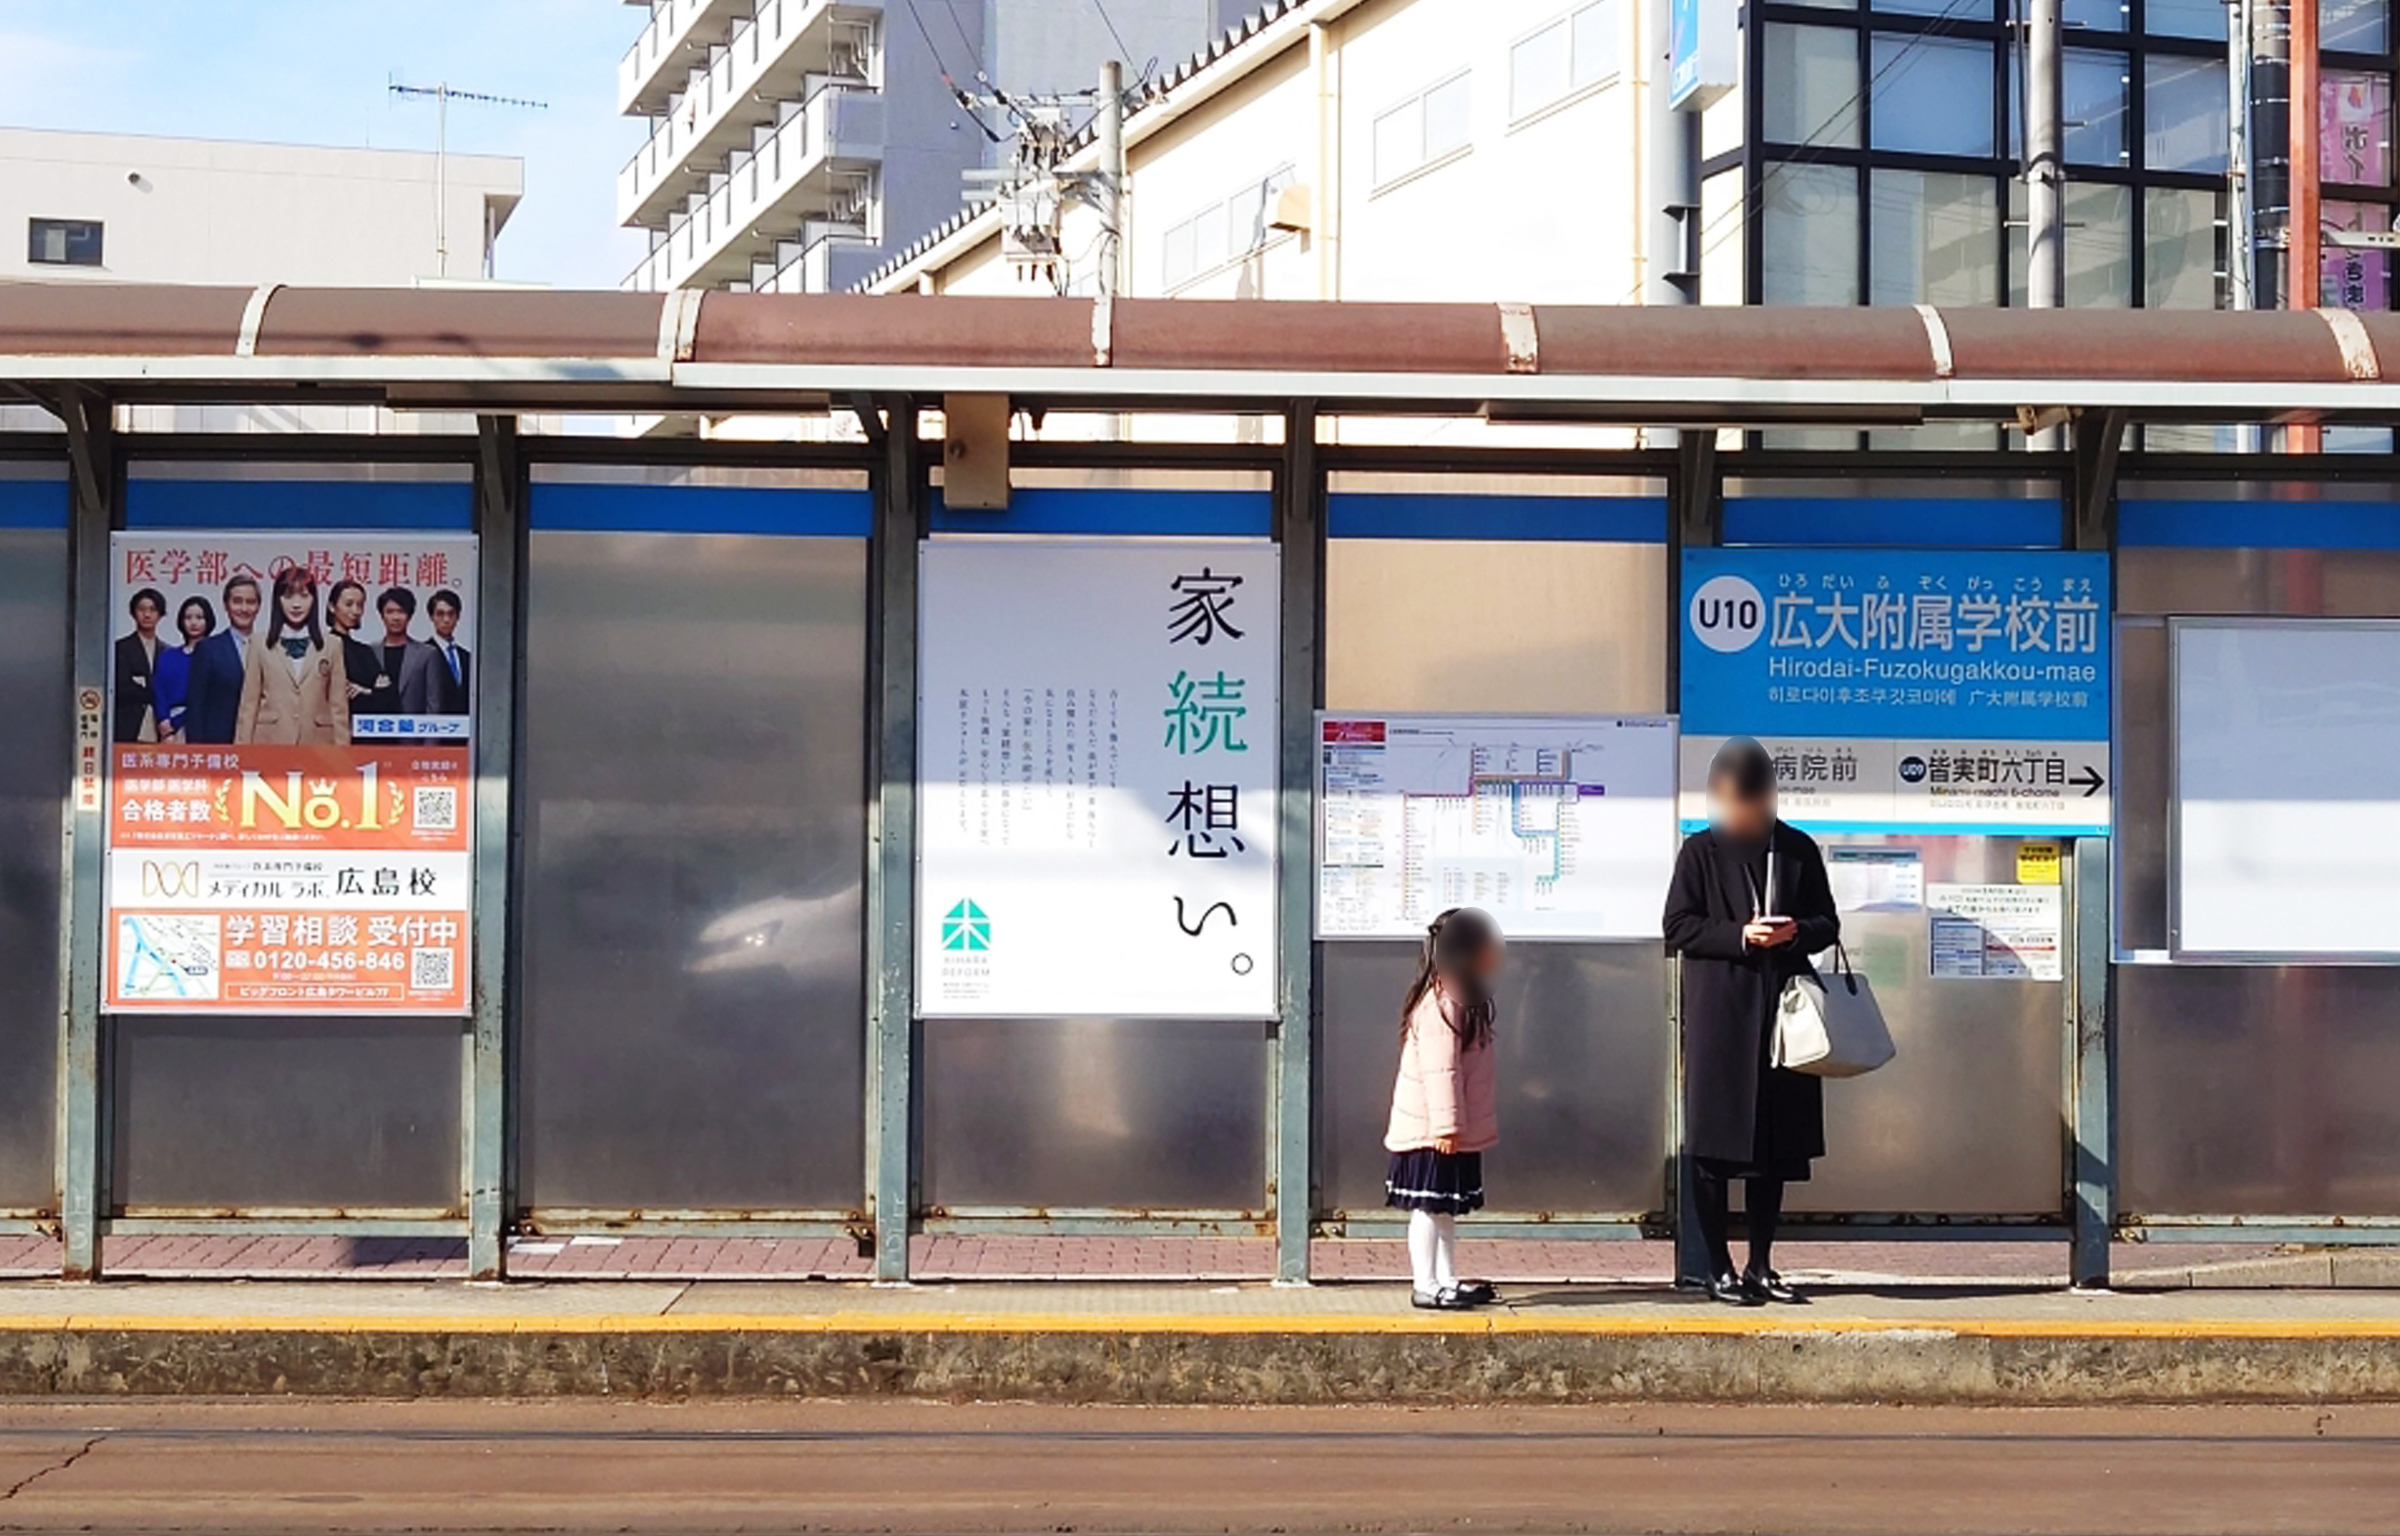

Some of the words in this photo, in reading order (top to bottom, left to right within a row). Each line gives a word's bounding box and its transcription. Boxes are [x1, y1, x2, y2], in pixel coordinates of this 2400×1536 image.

[126, 550, 462, 588] 医学部への最短距離。
[1779, 573, 1807, 588] ひろ
[1822, 574, 1854, 589] だい
[1877, 576, 1889, 588] ふ
[1919, 576, 1948, 590] ぞく
[1968, 577, 1993, 590] がっ
[2014, 578, 2043, 591] こう
[2063, 579, 2092, 592] まえ
[1699, 600, 1757, 629] U10
[1770, 591, 2099, 653] 広大附属学校前
[1770, 657, 2096, 684] Hirodai-Fuzokugakkou-mae
[357, 719, 460, 733] 河合塾グループ
[122, 753, 239, 769] 医系専門予備校
[1164, 567, 1253, 975] 家続想い。
[1774, 754, 1858, 782] 病院前
[1928, 756, 2065, 785] 皆実町六丁目
[241, 760, 382, 829] No.1
[121, 799, 211, 821] 合格者数
[208, 881, 285, 898] メディカル
[336, 867, 437, 896] 広島校
[226, 915, 360, 946] 学習相談
[367, 916, 457, 947] 受付中
[254, 952, 405, 970] 0120-456-846
